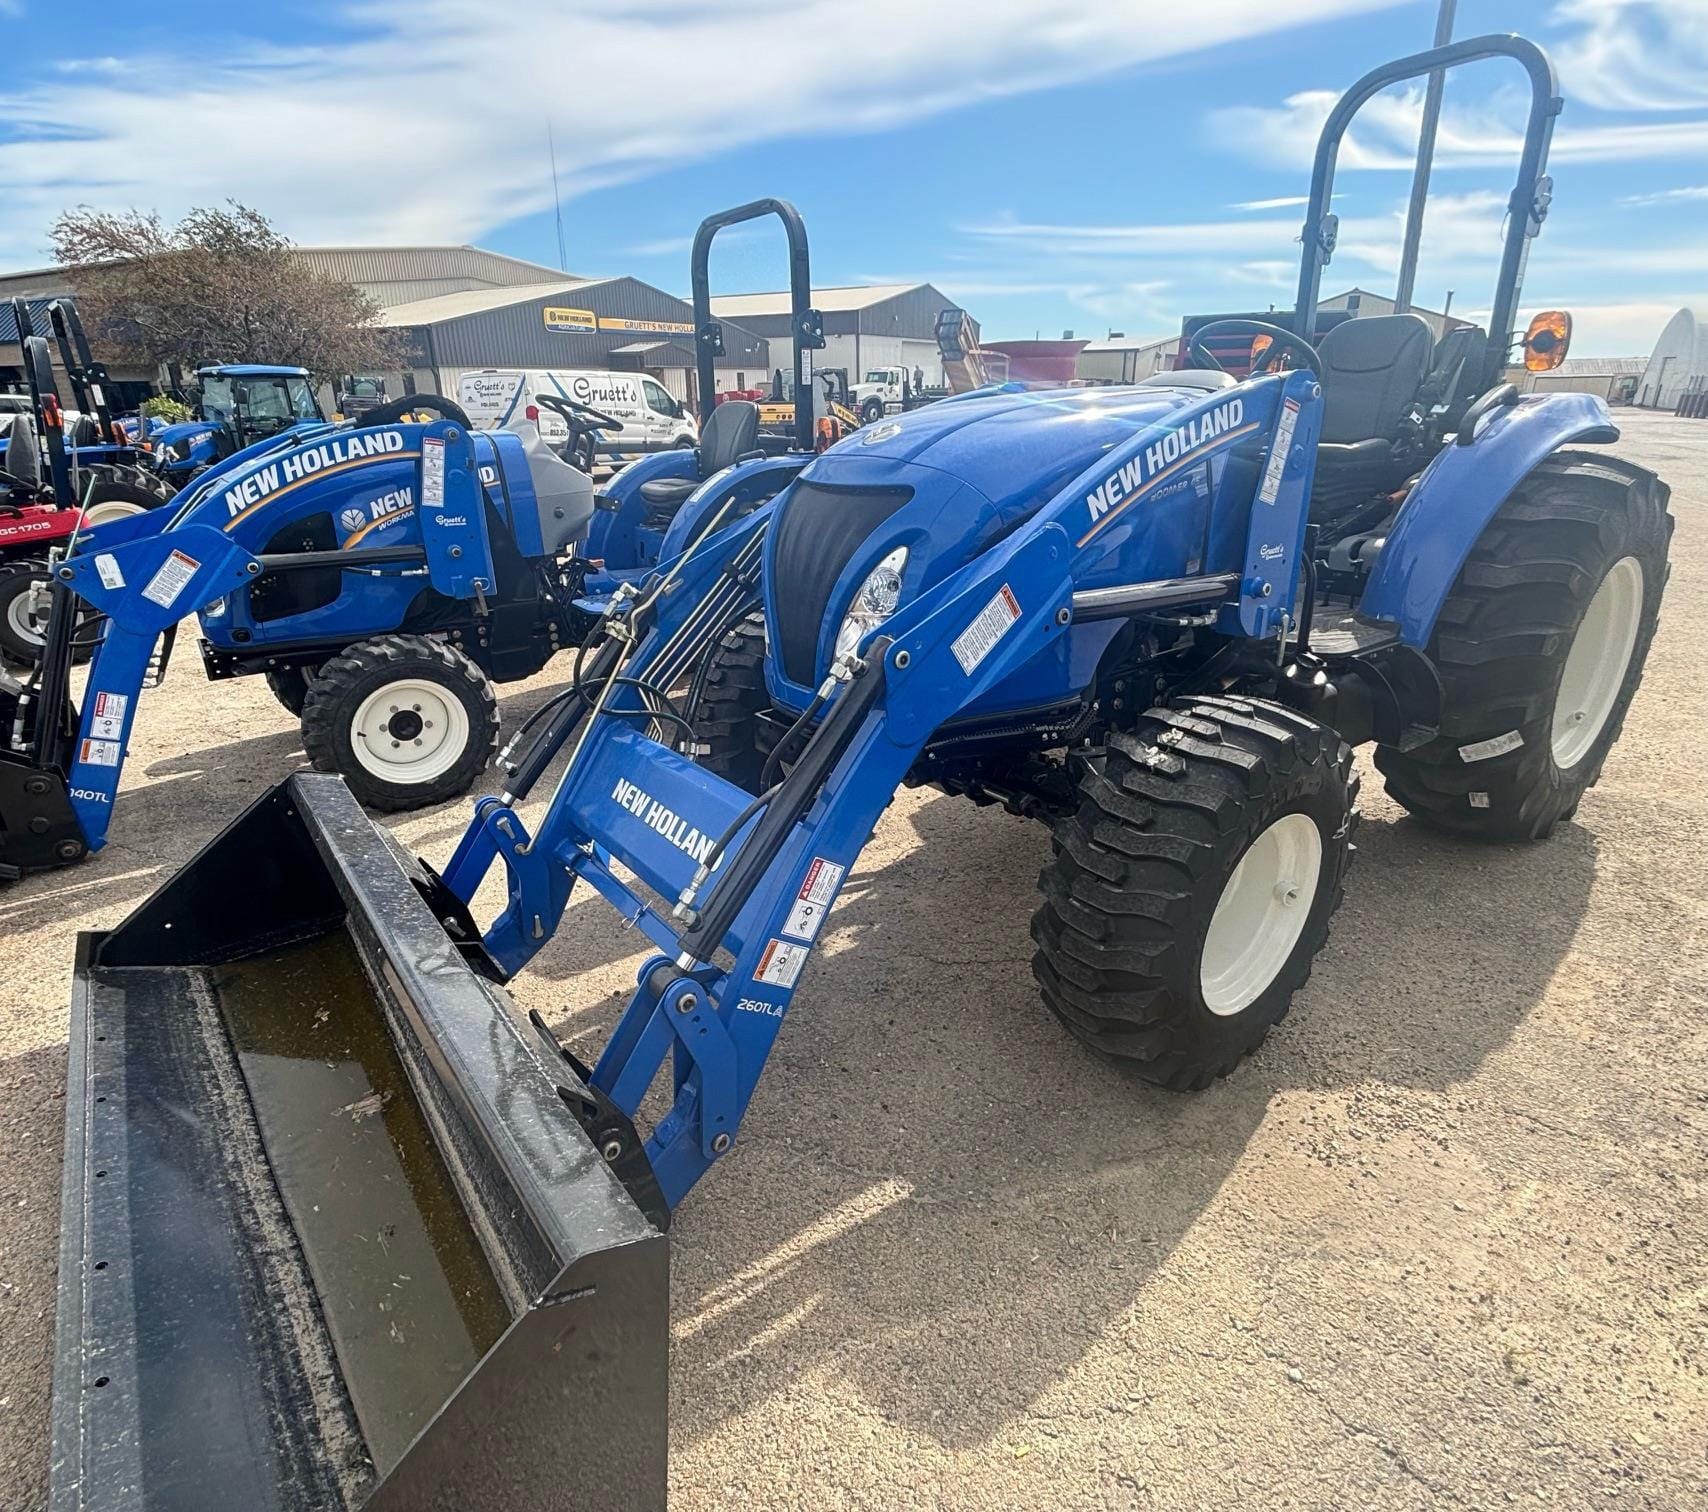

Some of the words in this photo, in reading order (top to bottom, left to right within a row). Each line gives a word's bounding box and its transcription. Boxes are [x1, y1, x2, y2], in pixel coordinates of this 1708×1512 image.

[674, 324, 694, 332] HOLLA
[573, 377, 637, 406] Gruett's
[224, 464, 279, 517] NEW
[283, 431, 403, 482] HOLLAND
[1086, 455, 1143, 523] NEW
[1145, 398, 1243, 476] HOLLAND
[369, 487, 413, 520] NEW
[378, 510, 415, 532] WORKMA
[611, 777, 651, 818] NEW
[805, 861, 822, 890] DANGER
[736, 998, 783, 1018] 260TLA
